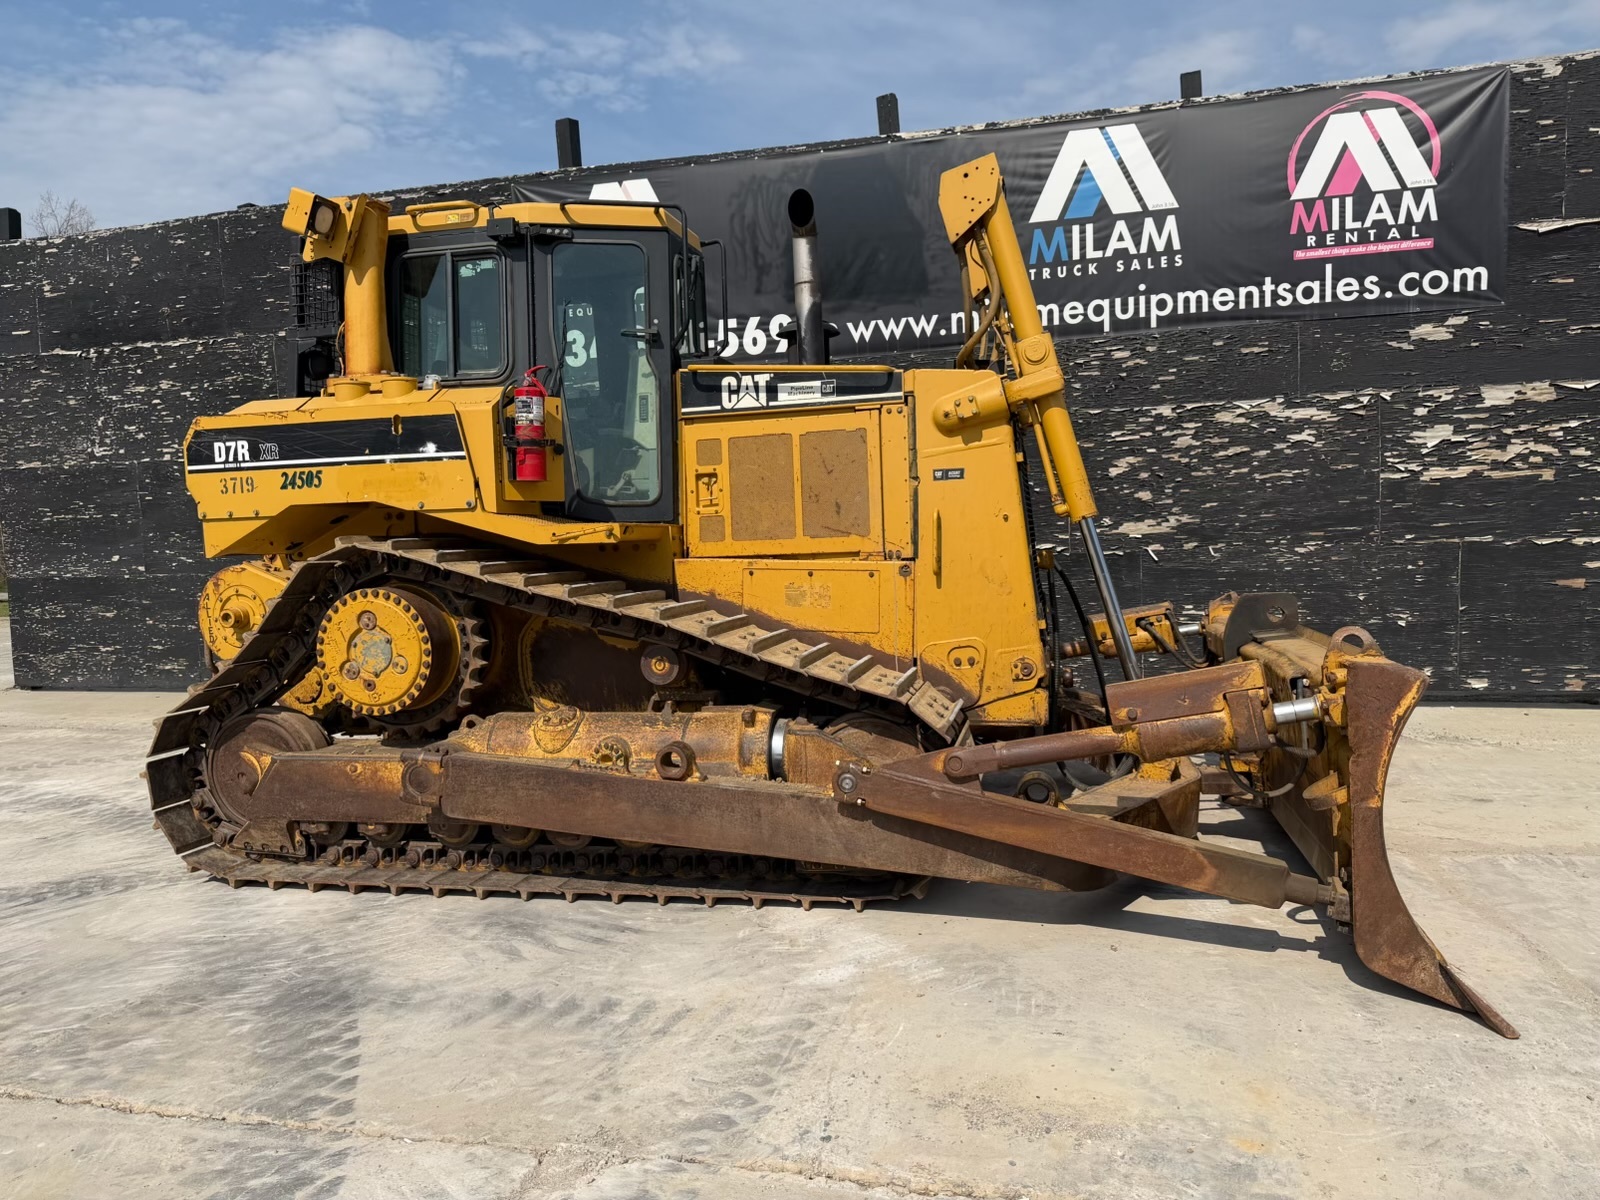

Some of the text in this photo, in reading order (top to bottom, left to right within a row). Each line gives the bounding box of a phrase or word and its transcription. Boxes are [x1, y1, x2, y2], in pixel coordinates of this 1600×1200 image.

[1290, 188, 1438, 234] MILAM
[1029, 215, 1181, 265] MILAM
[1296, 250, 1306, 258] The
[1306, 248, 1332, 257] smallest
[1332, 247, 1350, 256] things
[1377, 242, 1400, 252] biggest
[1400, 239, 1432, 249] difference
[1306, 225, 1420, 247] RENTAL
[1029, 254, 1183, 281] TRUCK SALES
[846, 263, 1488, 344] www.mmequipmentsales.com
[721, 373, 771, 410] CAT
[821, 384, 834, 393] CAT
[213, 440, 279, 463] D7R XR
[220, 470, 323, 495] 3719 24505
